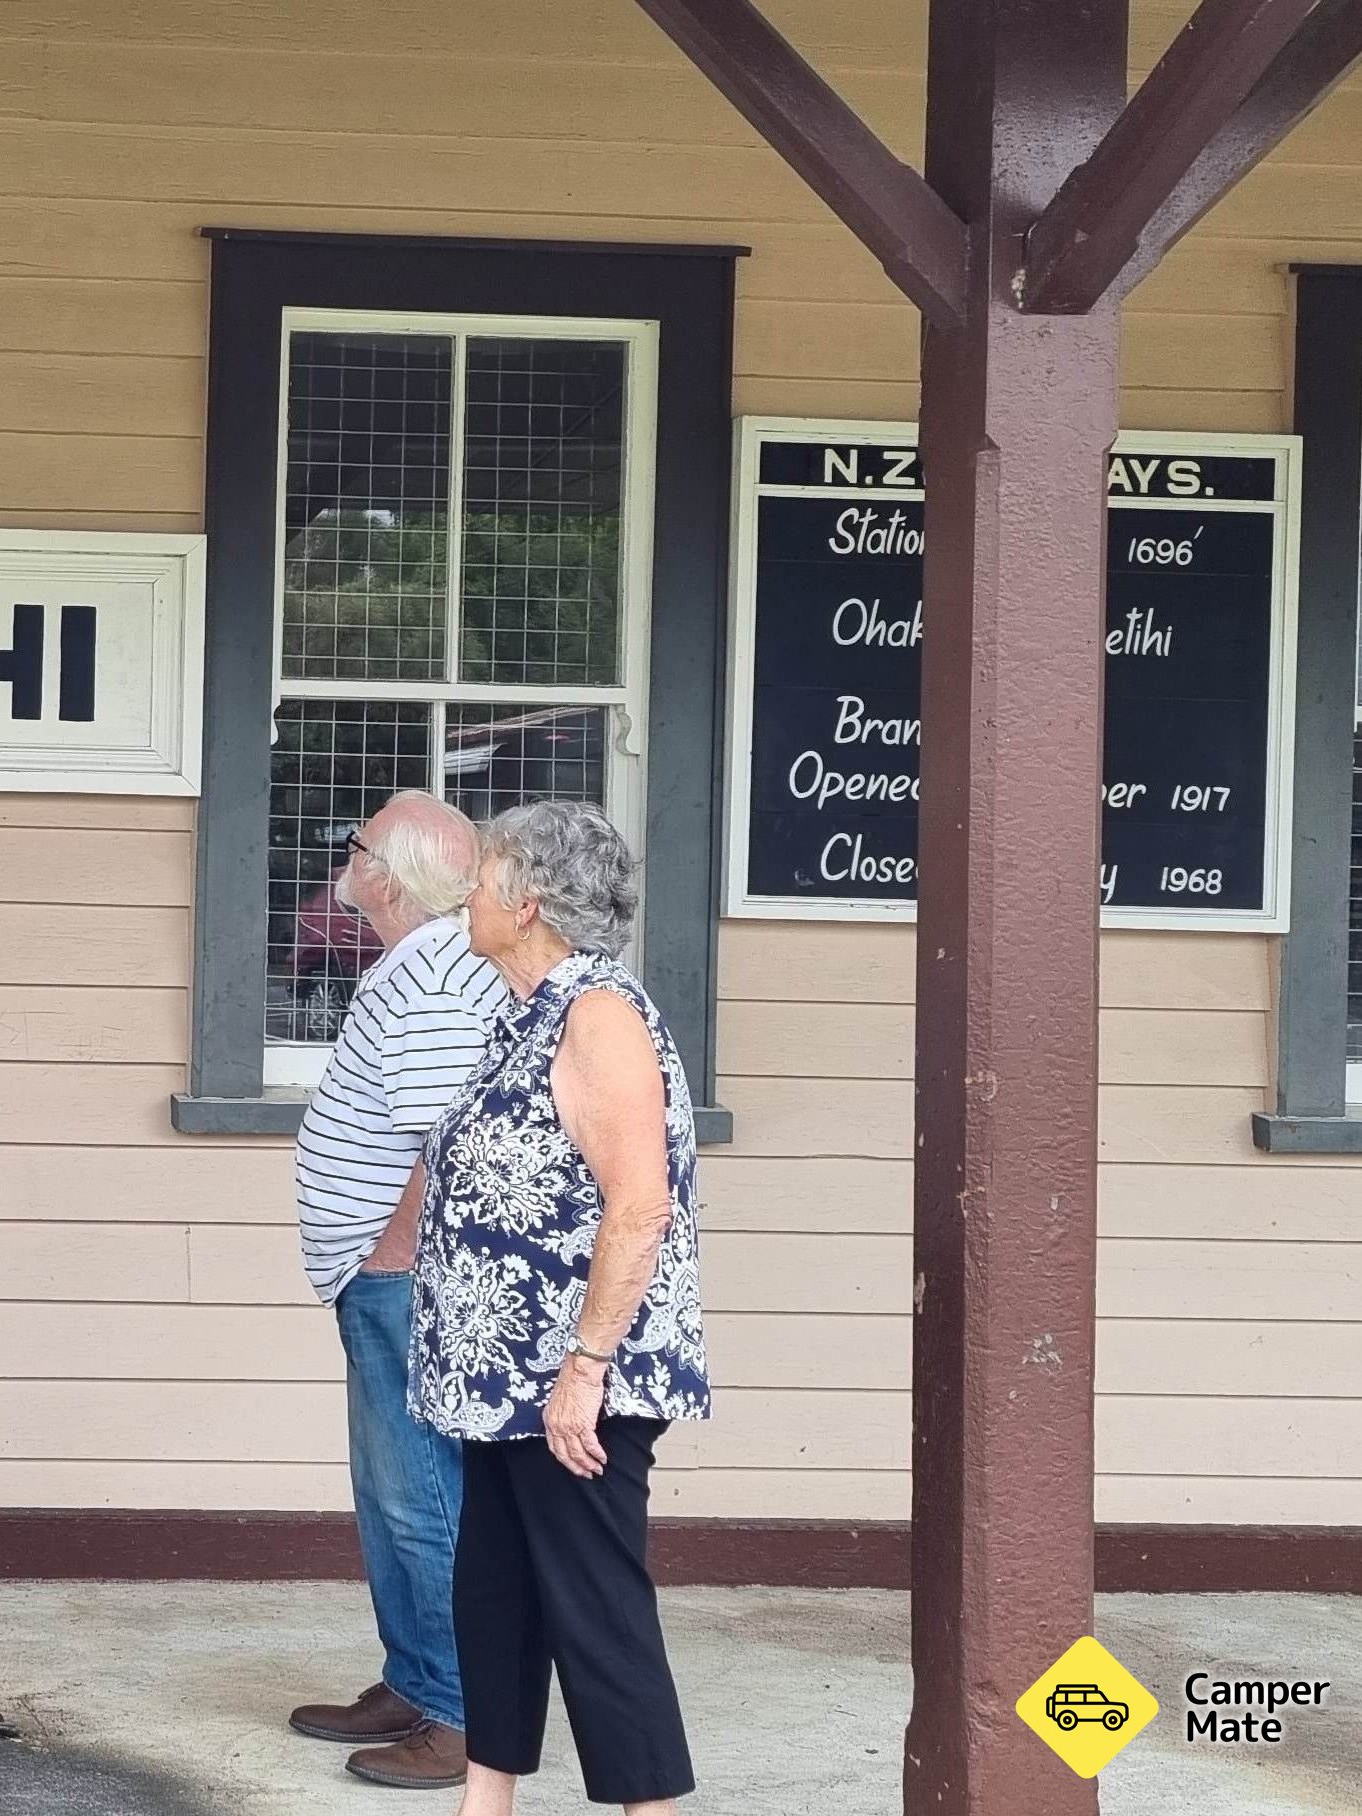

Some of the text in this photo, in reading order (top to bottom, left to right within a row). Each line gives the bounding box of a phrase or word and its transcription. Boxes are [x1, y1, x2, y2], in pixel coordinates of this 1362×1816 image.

[1171, 785, 1230, 812] 1917
[820, 832, 919, 883] Close
[1160, 866, 1223, 894] 1968
